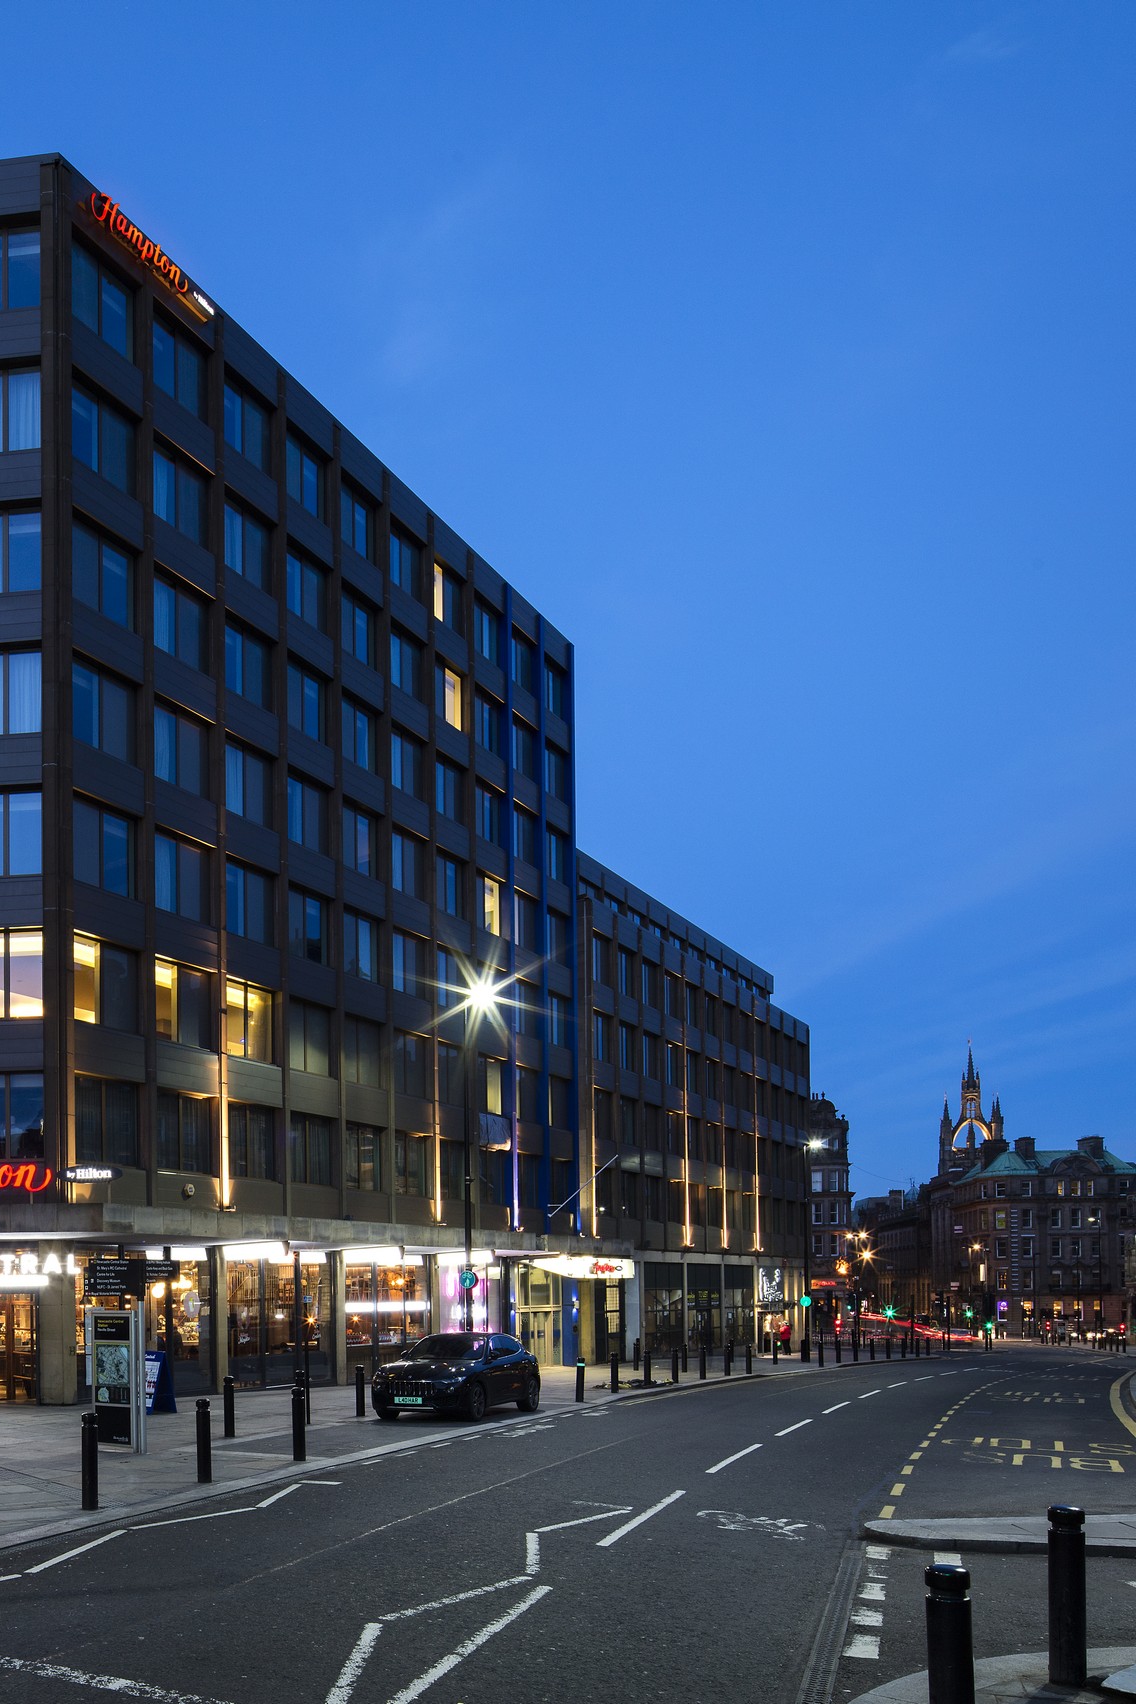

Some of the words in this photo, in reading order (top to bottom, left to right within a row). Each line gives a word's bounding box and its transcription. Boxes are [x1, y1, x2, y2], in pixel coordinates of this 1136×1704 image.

[91, 192, 189, 292] Hampton
[66, 1171, 75, 1180] by
[76, 1168, 112, 1180] Hilton
[941, 1437, 1136, 1456] STOP
[960, 1451, 1125, 1473] BUS
